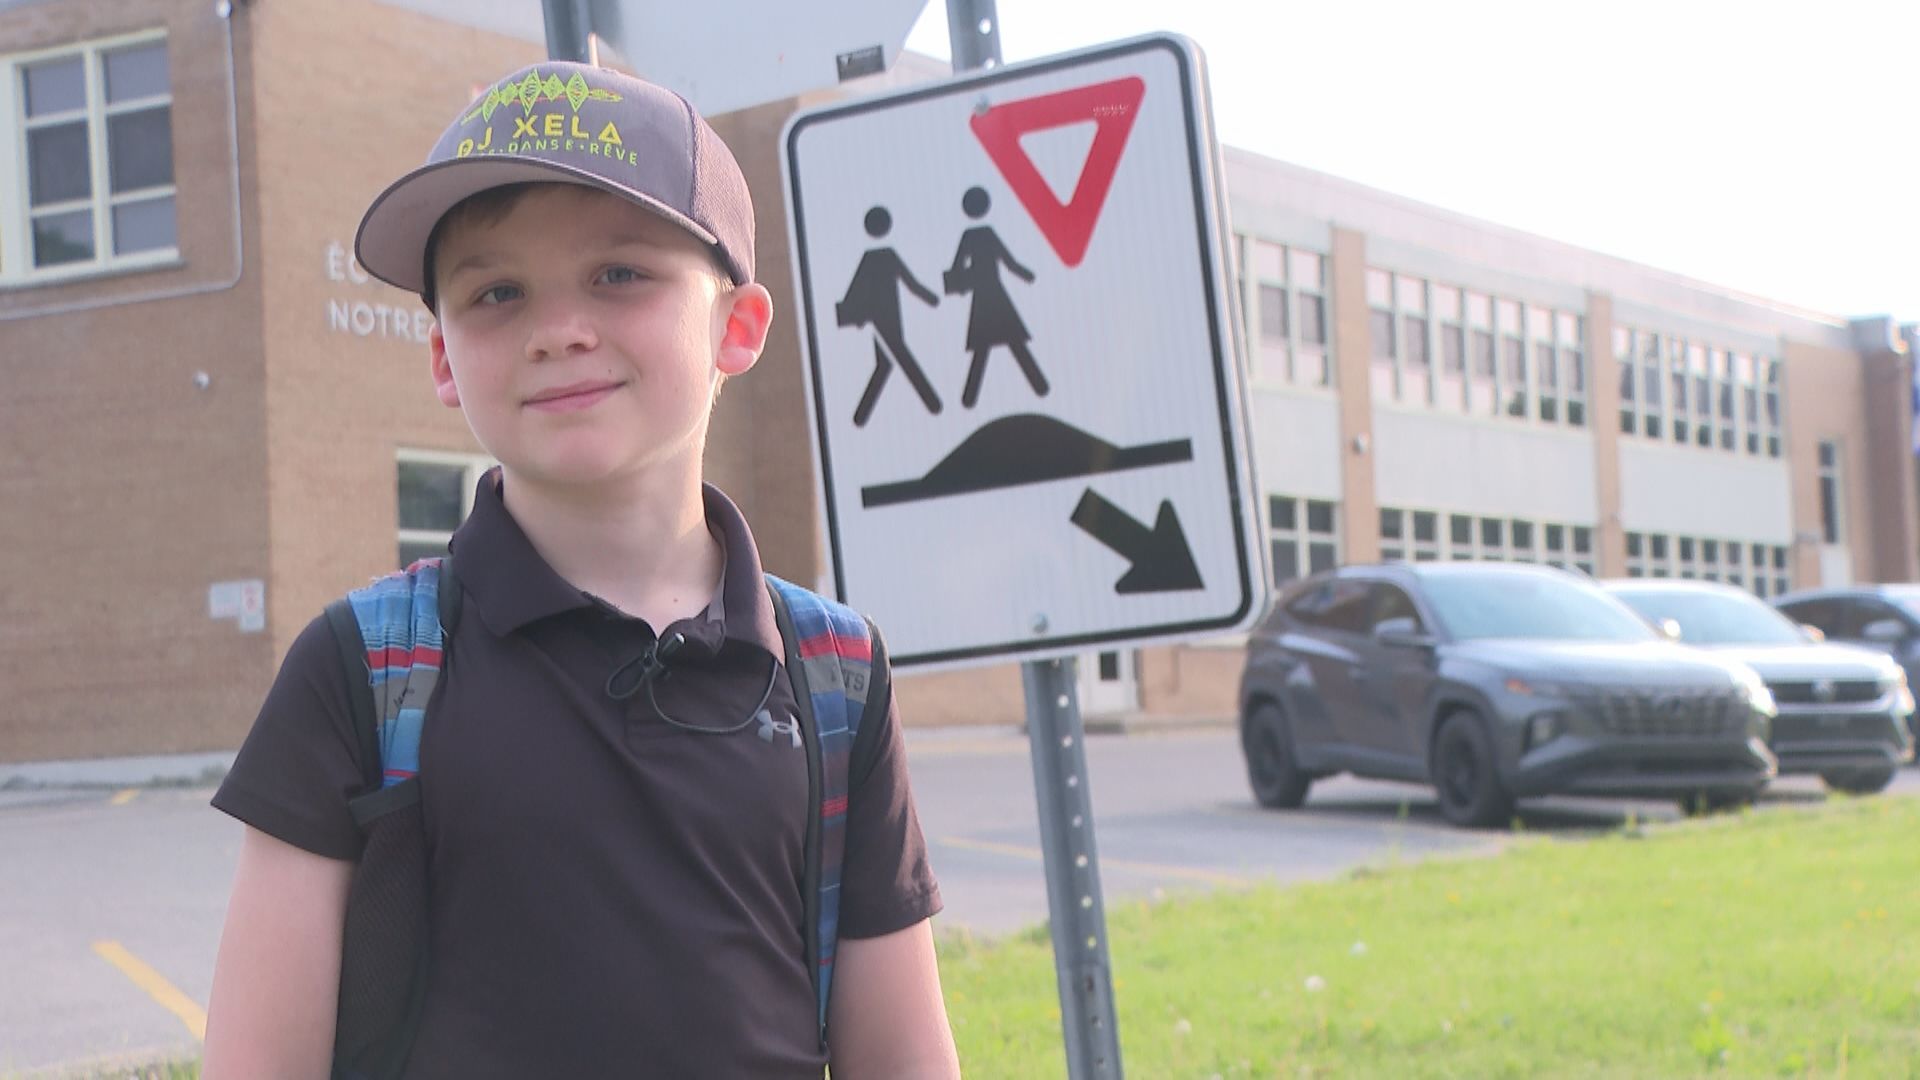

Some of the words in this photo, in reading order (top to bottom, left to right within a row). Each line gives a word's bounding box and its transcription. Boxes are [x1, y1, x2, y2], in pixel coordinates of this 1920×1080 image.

[457, 127, 492, 157] DJ
[512, 113, 623, 145] XELA
[328, 299, 429, 343] NOTRE
